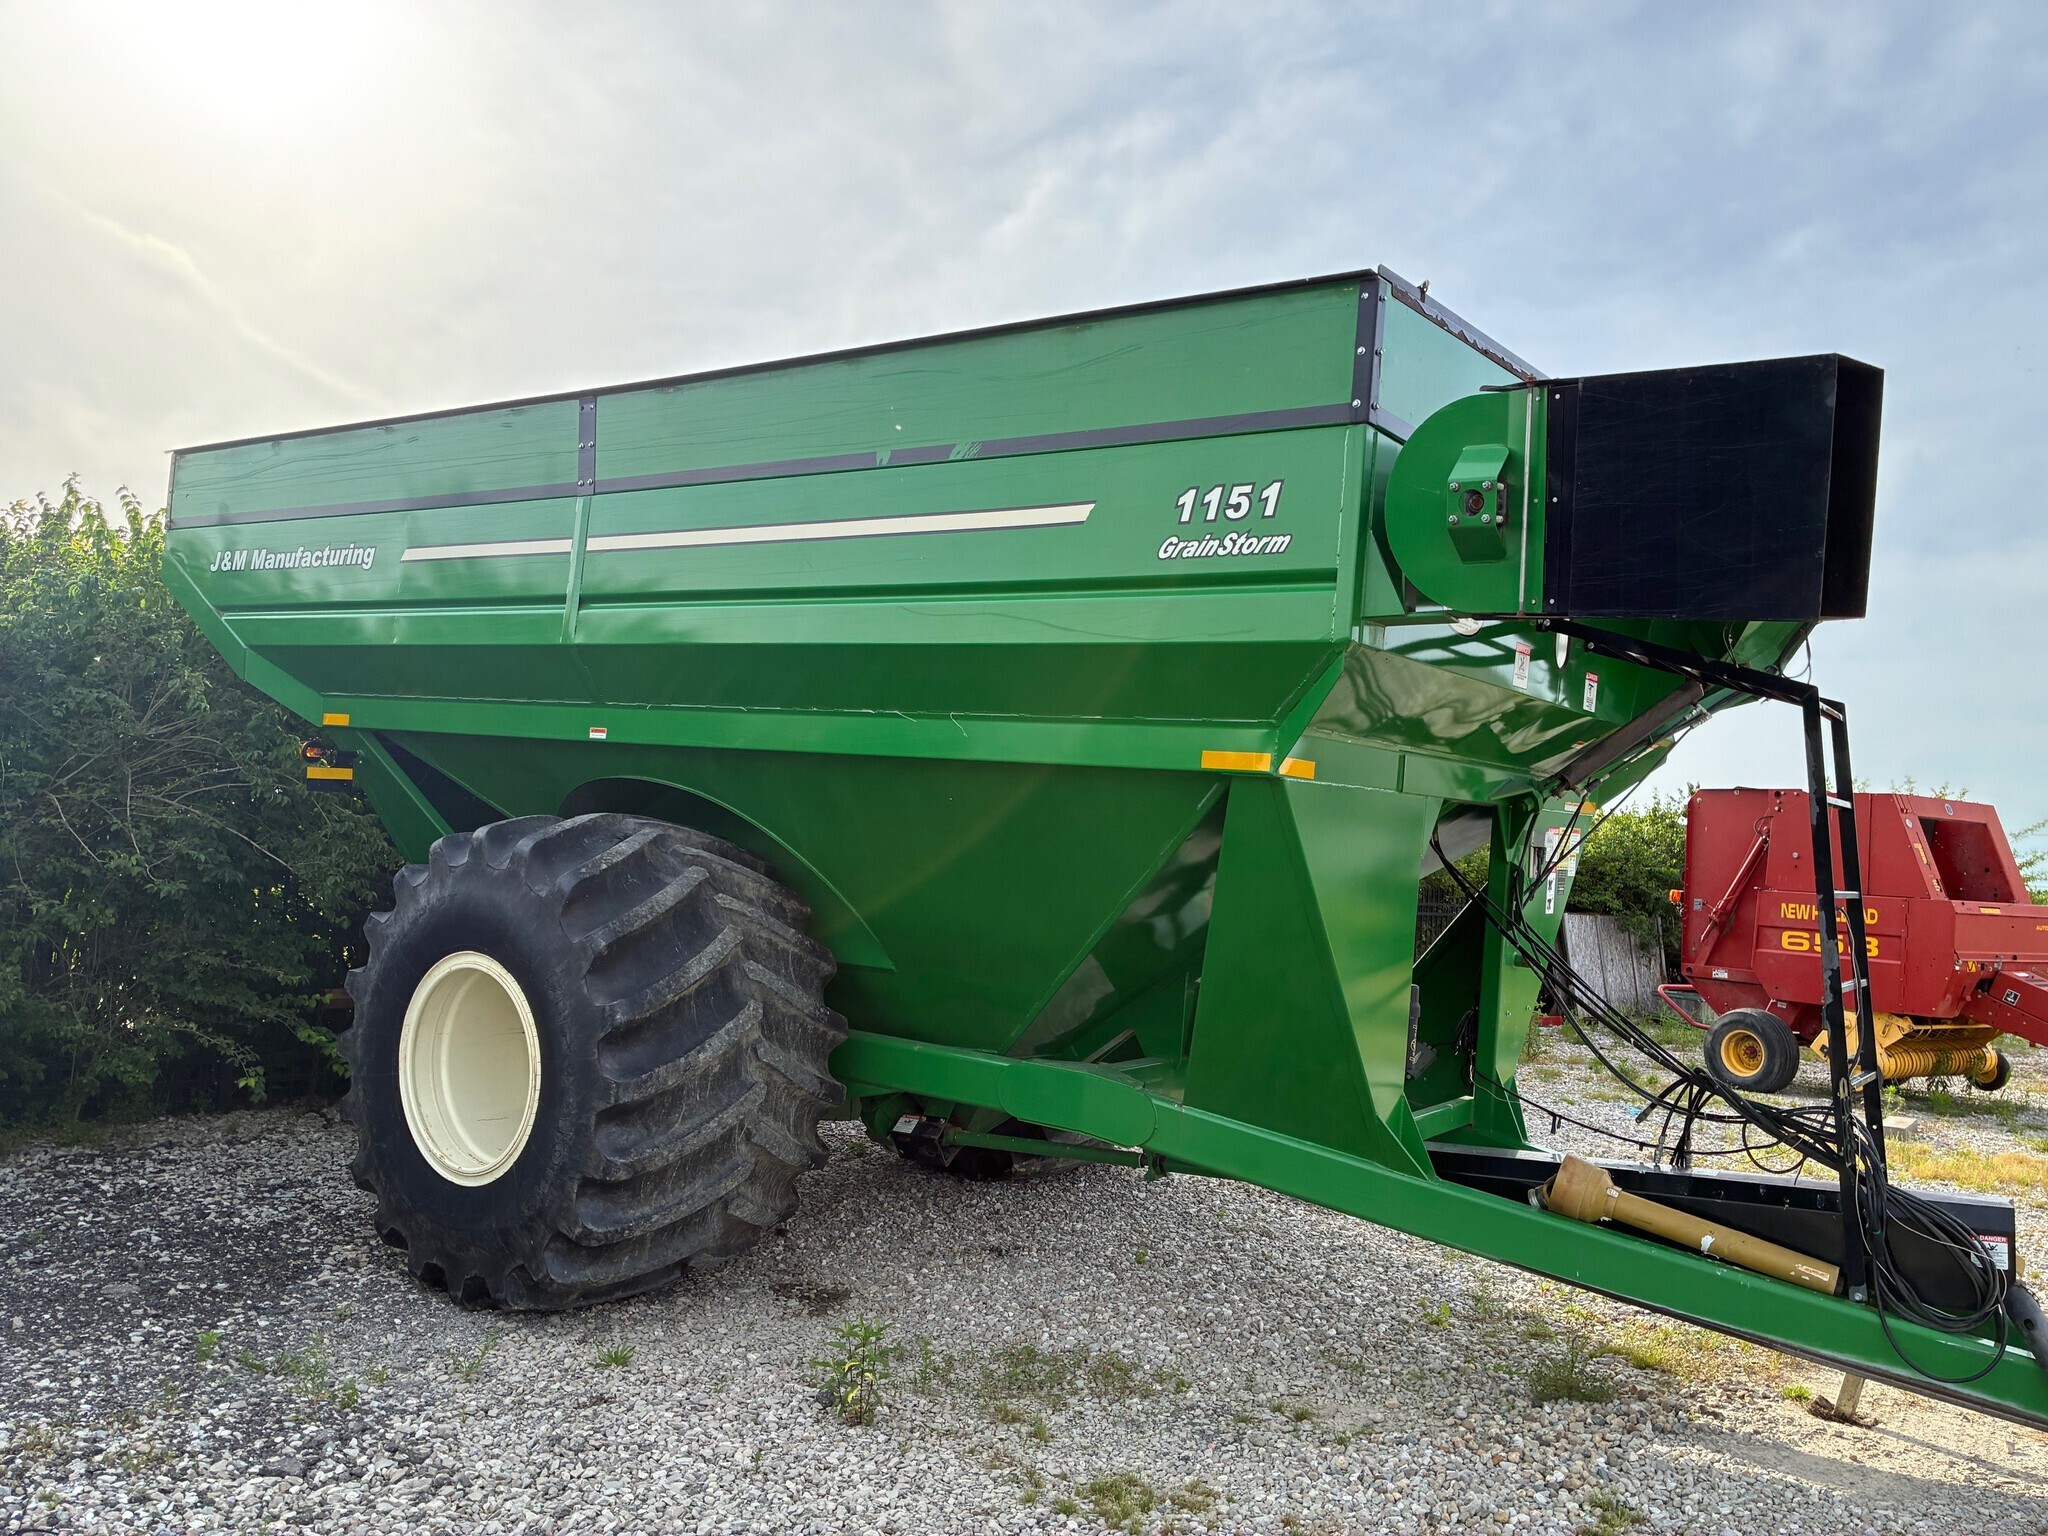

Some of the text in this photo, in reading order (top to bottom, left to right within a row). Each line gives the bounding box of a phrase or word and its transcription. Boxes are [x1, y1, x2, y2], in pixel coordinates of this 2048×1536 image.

[1175, 480, 1284, 524] 1151
[210, 543, 376, 572] J&M Manufacturing
[1158, 530, 1292, 559] GrainStorm
[1781, 903, 1810, 920] NEW
